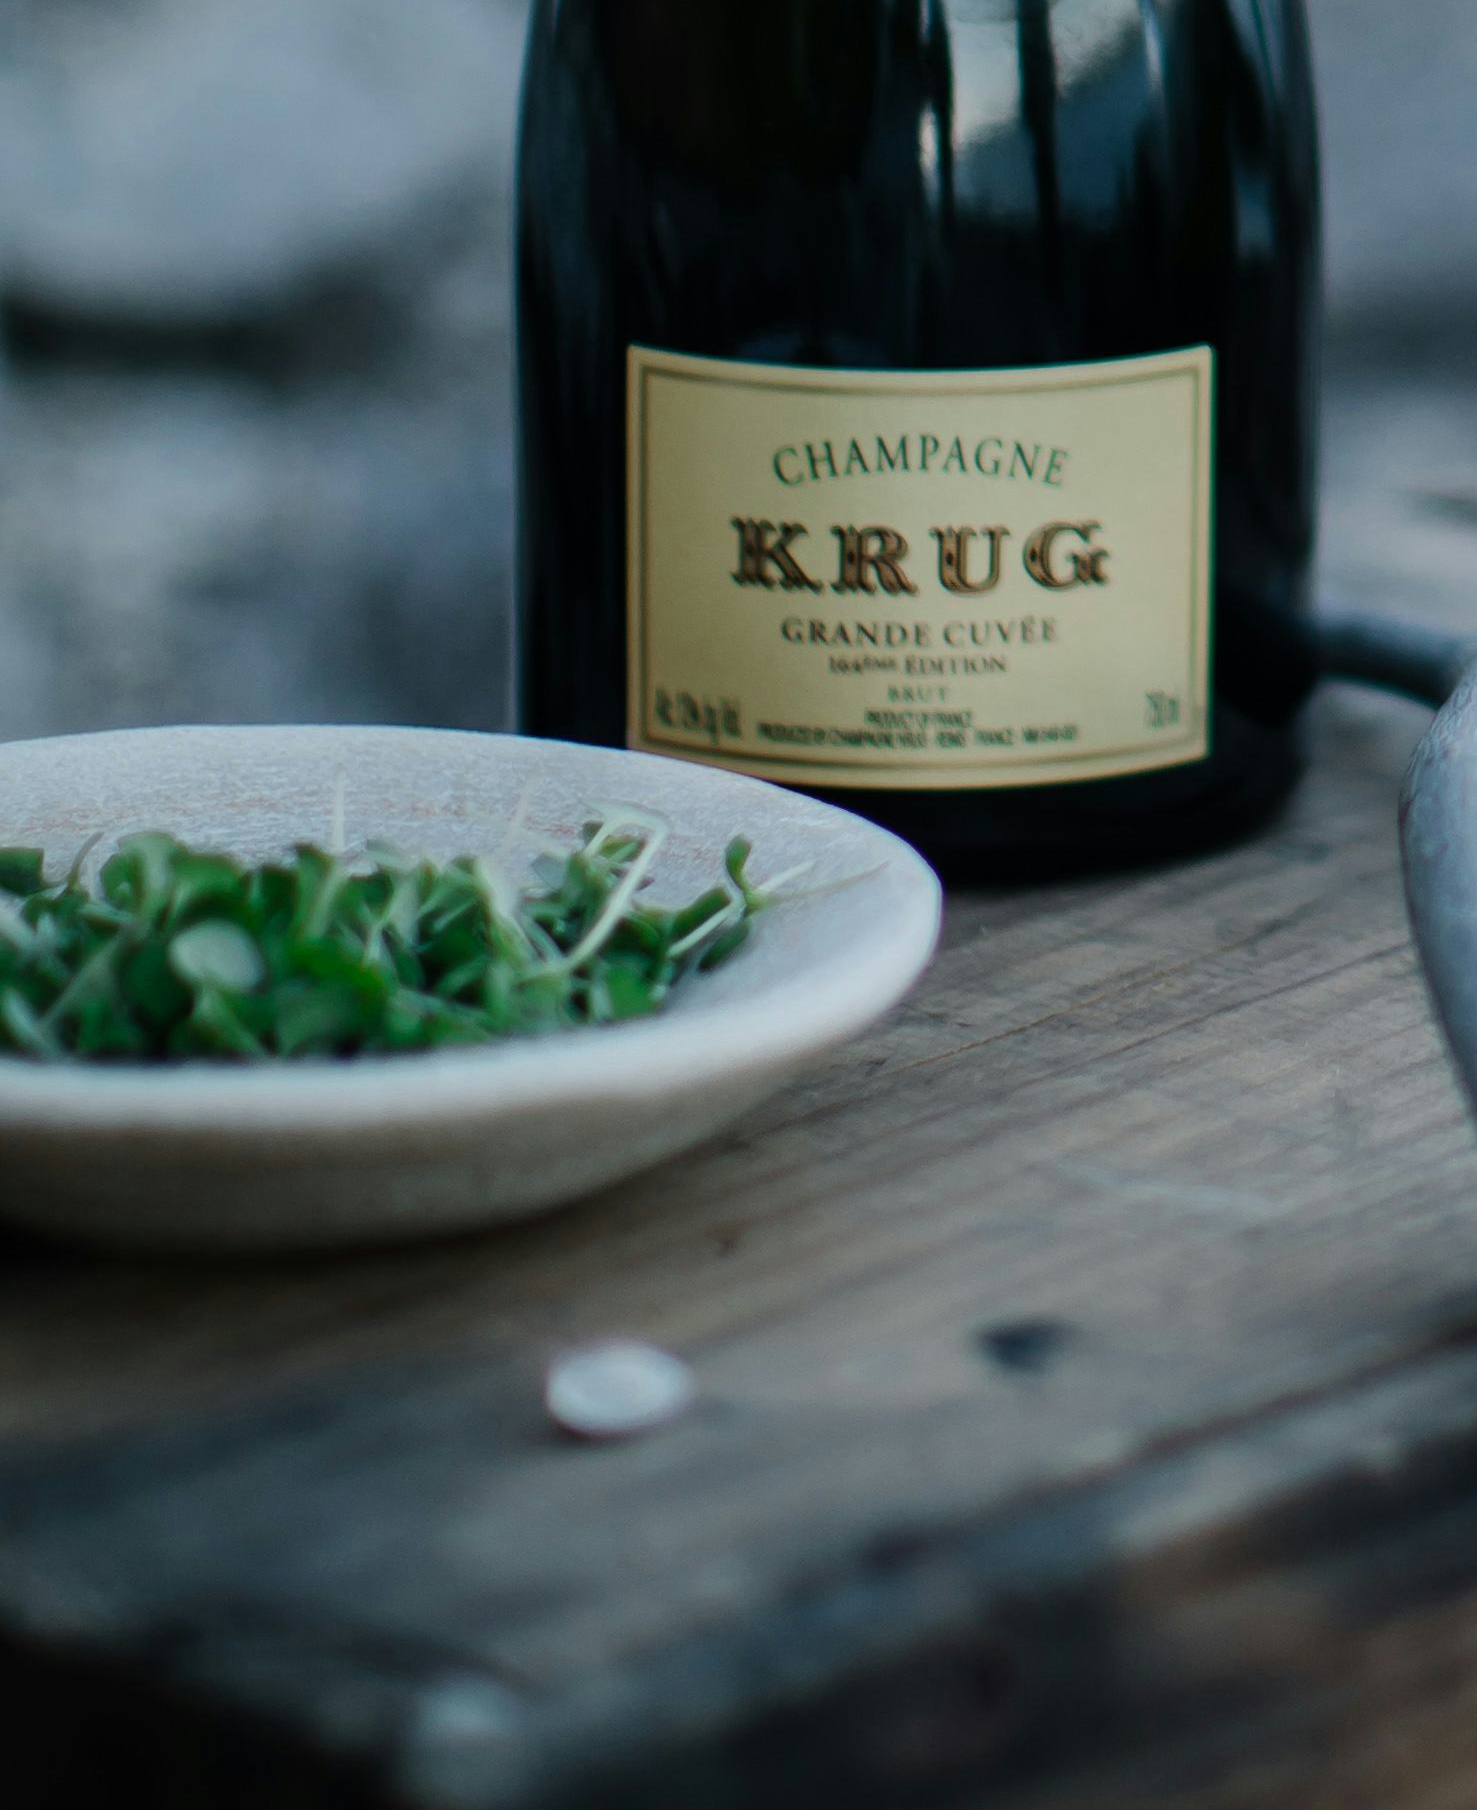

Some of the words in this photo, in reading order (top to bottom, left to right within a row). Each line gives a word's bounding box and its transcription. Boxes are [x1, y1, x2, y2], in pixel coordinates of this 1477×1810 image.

[773, 435, 1069, 487] CHAMPAGNE
[731, 517, 1110, 596] KRUG
[780, 618, 931, 647] GRANDE
[943, 616, 1057, 647] CUVÉE
[888, 686, 948, 702] BRUT
